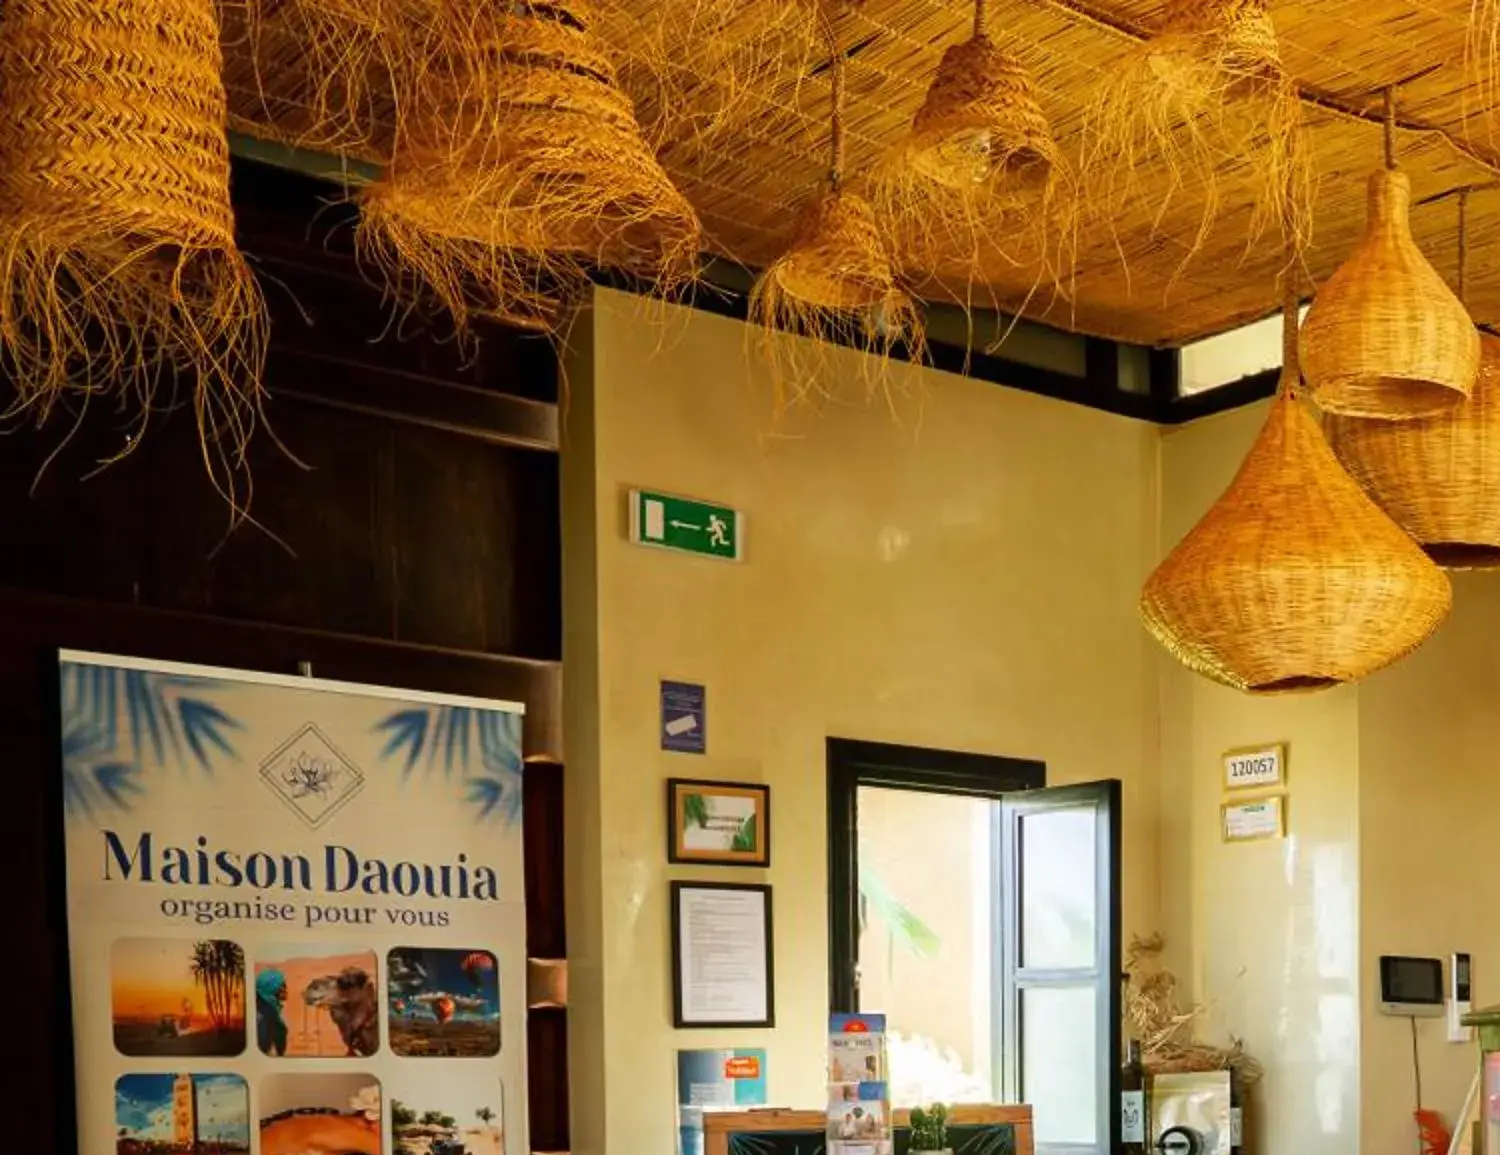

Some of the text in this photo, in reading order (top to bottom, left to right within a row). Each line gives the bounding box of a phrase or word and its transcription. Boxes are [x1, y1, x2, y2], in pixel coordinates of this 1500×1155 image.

[101, 829, 500, 902] Maison Daouia
[160, 895, 450, 929] organise pour vous
